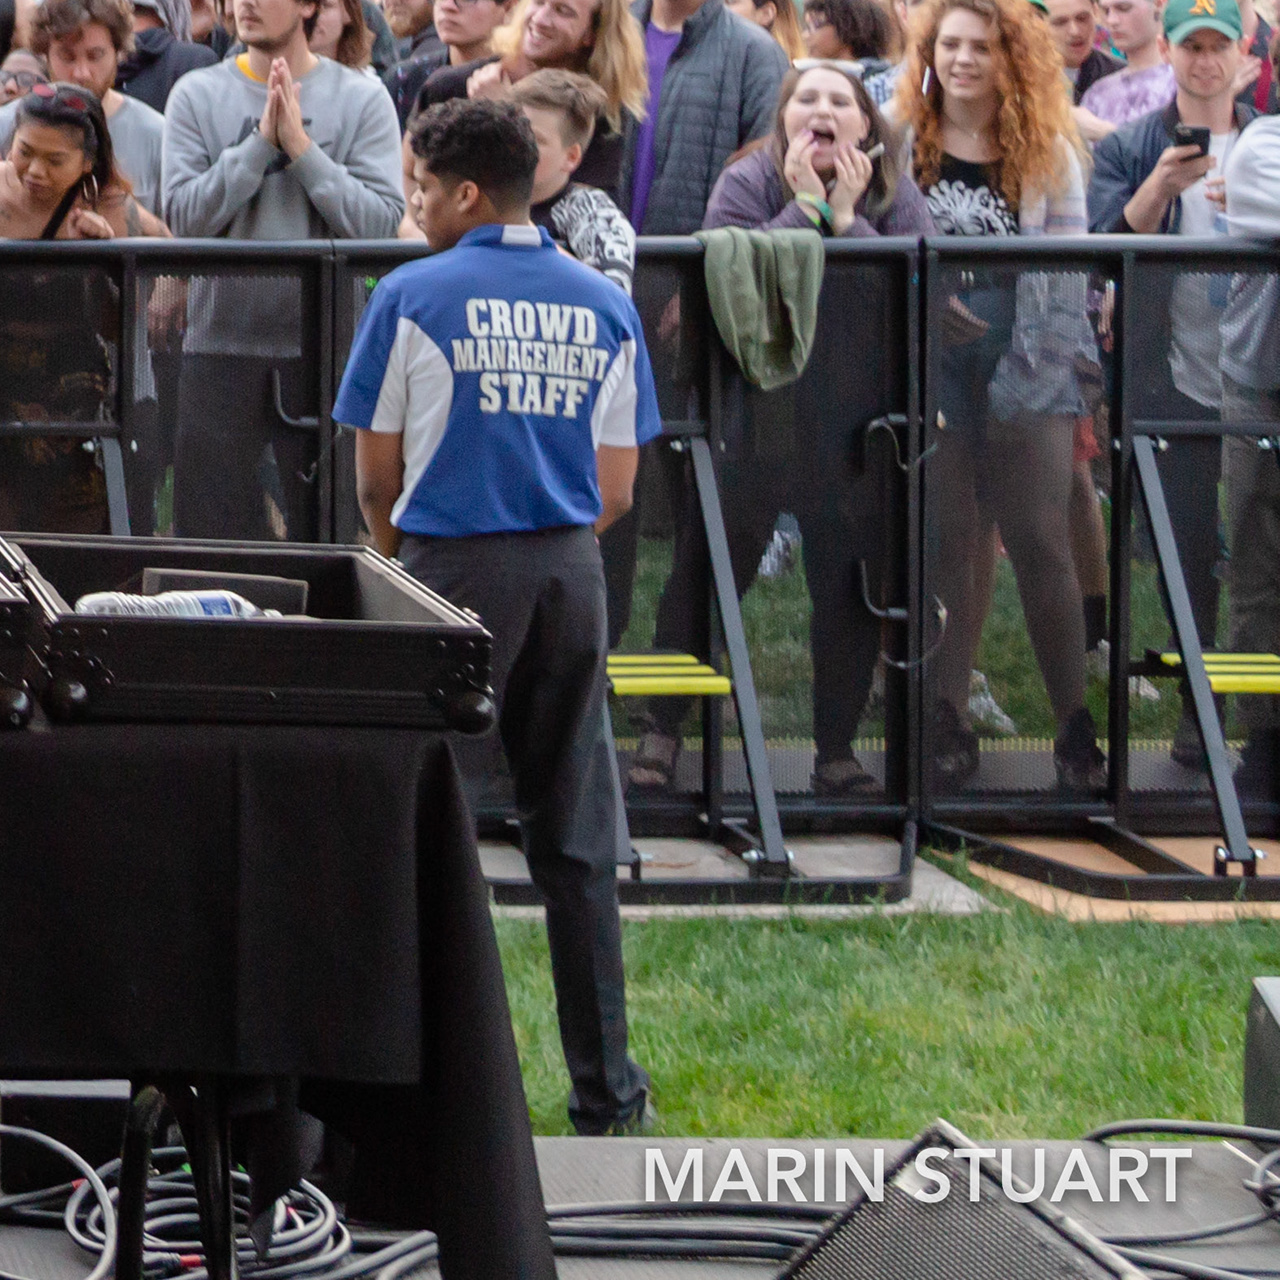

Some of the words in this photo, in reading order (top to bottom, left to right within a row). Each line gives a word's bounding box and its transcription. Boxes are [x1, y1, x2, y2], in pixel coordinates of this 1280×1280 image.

[466, 298, 597, 345] CROWD
[451, 338, 609, 382] MANAGEMENT
[479, 372, 589, 418] STAFF
